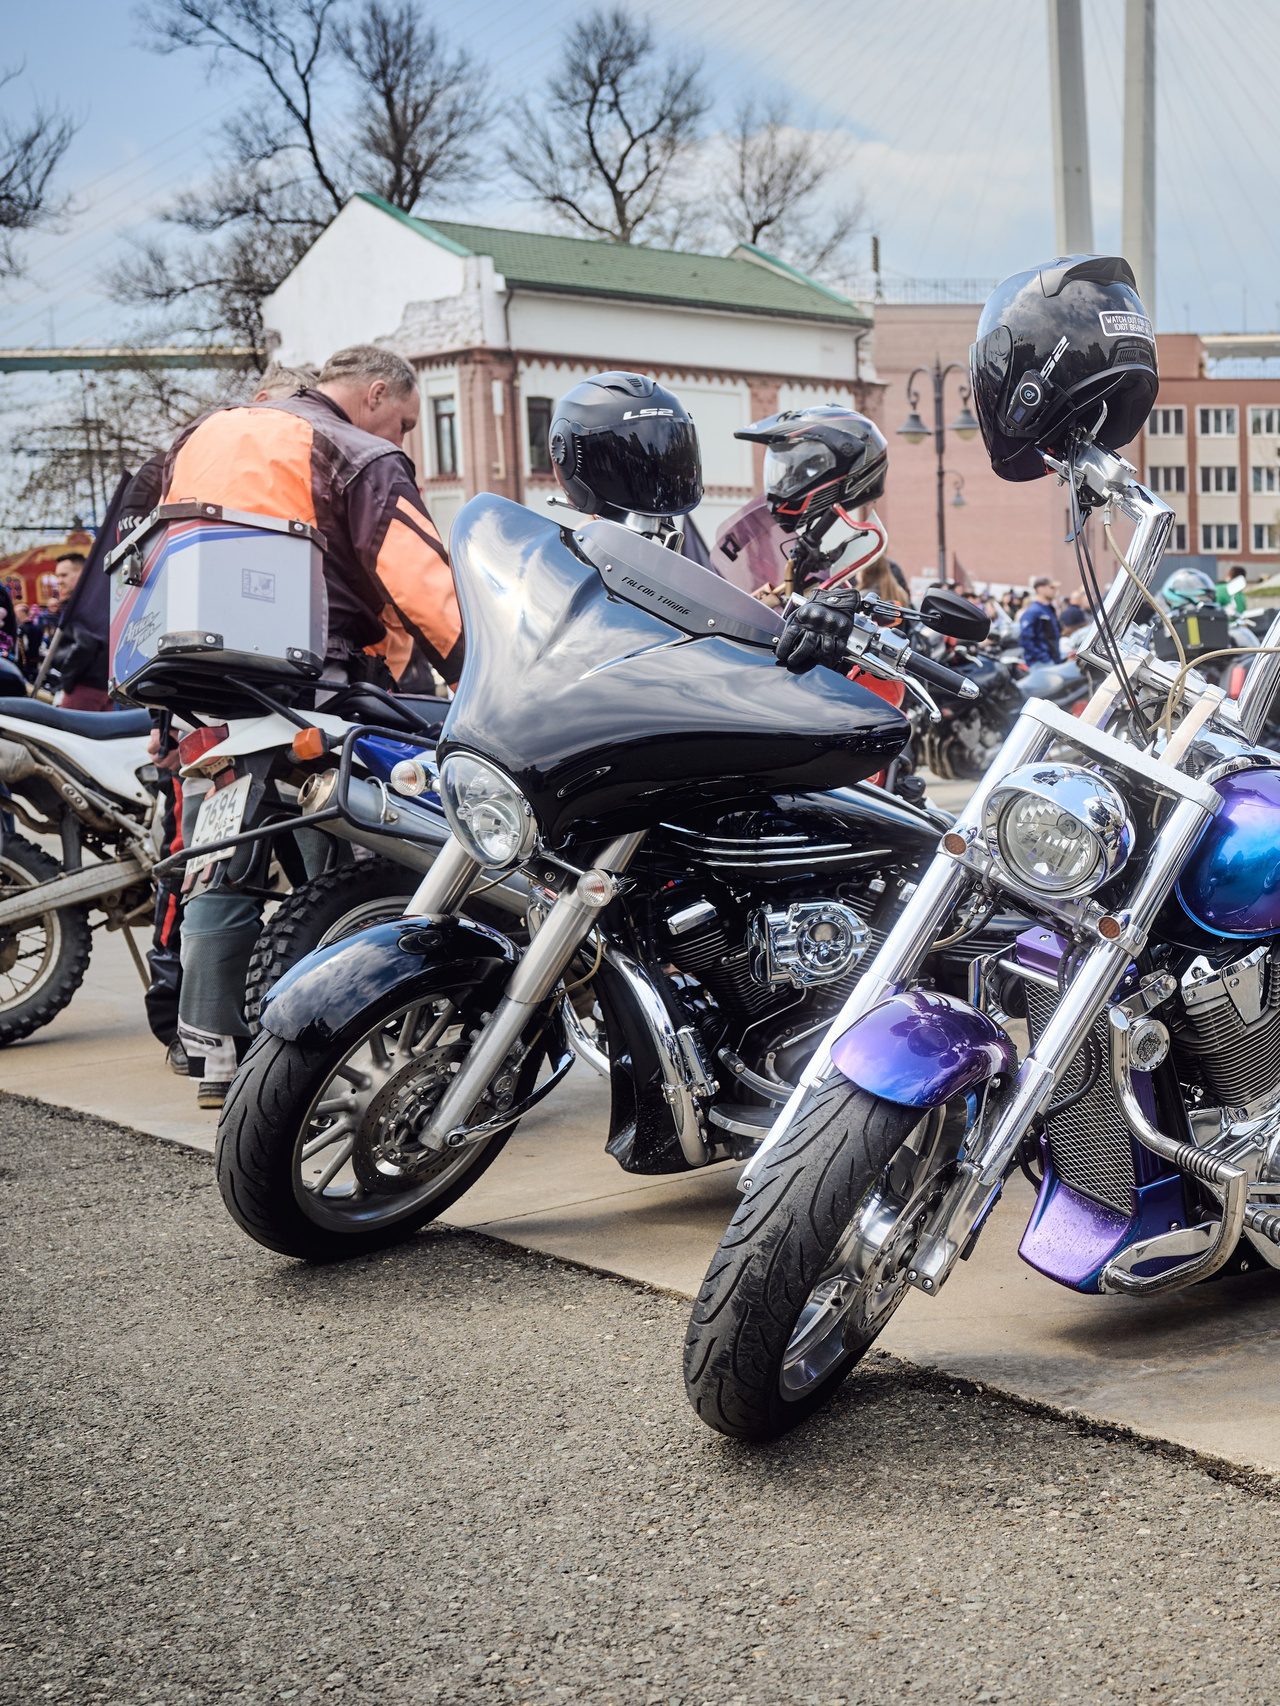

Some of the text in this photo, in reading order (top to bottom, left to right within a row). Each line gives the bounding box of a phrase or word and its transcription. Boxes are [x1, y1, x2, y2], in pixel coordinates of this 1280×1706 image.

[1105, 316, 1127, 324] WATCH
[1040, 335, 1070, 381] S2
[622, 408, 674, 420] LS2
[621, 576, 692, 616] FALCON TUNING
[201, 787, 237, 832] 7694
